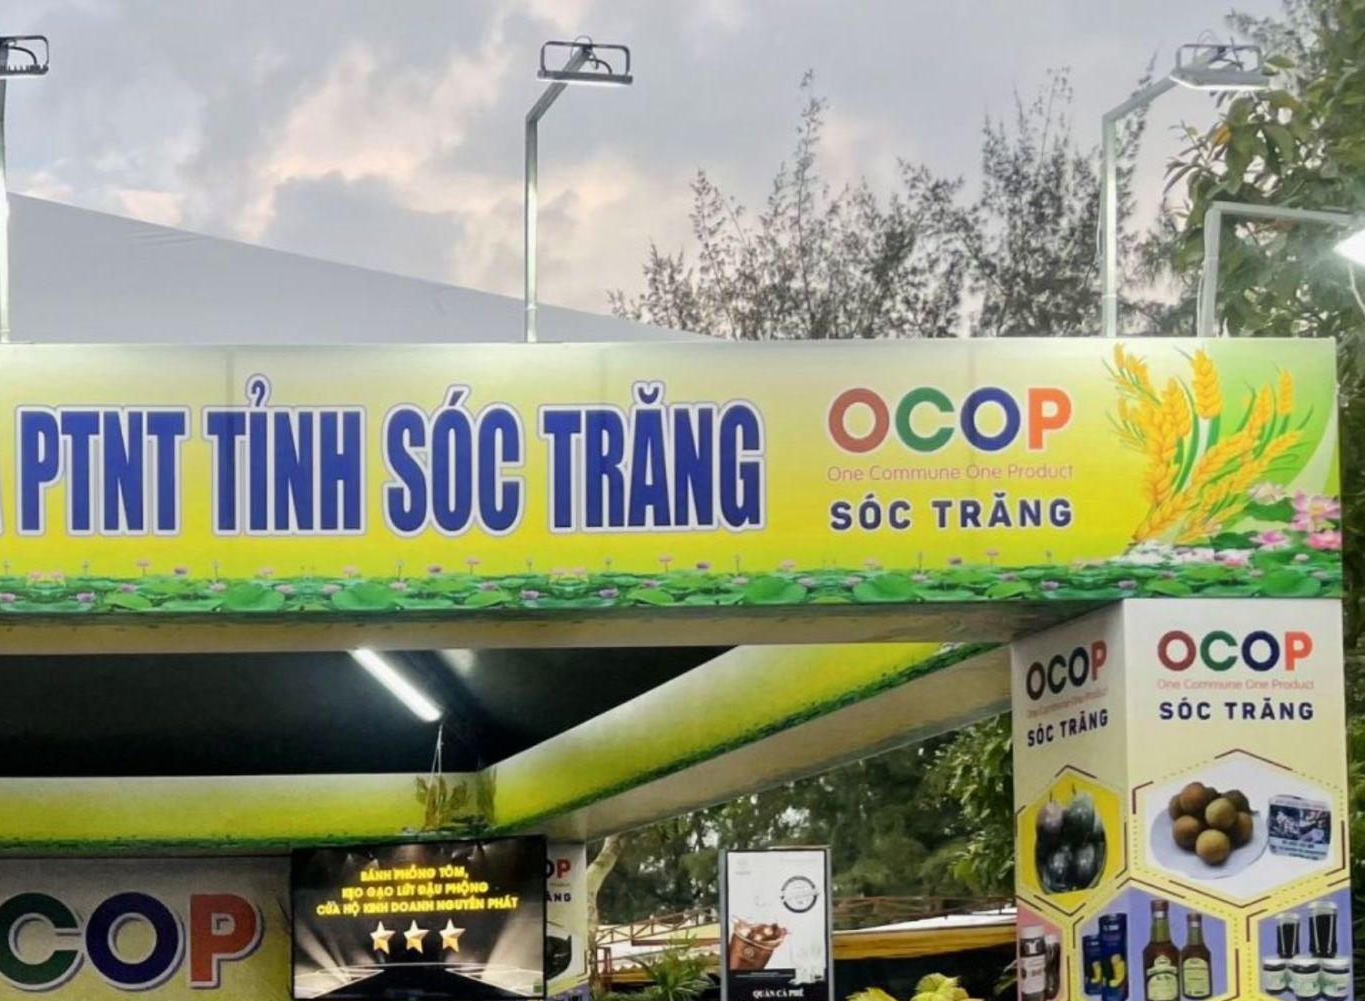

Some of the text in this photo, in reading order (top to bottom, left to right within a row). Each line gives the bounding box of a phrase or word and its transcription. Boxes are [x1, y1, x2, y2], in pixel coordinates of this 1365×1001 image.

[828, 386, 1072, 452] OCOP
[19, 408, 185, 532] PTNT
[206, 378, 361, 532] TỈNH
[386, 389, 521, 533] SÓC
[542, 384, 761, 530] TRĂNG
[828, 463, 1073, 481] One Commune One Product
[830, 492, 1072, 530] SÓC TRĂNG
[1157, 630, 1313, 672] OCOP
[1026, 640, 1107, 701] OCOP
[1157, 679, 1315, 690] One Commune One Product
[1027, 708, 1108, 747] SÓC TRĂNG
[1159, 697, 1314, 720] SÓC TRĂNG
[390, 901, 435, 913] DOANH
